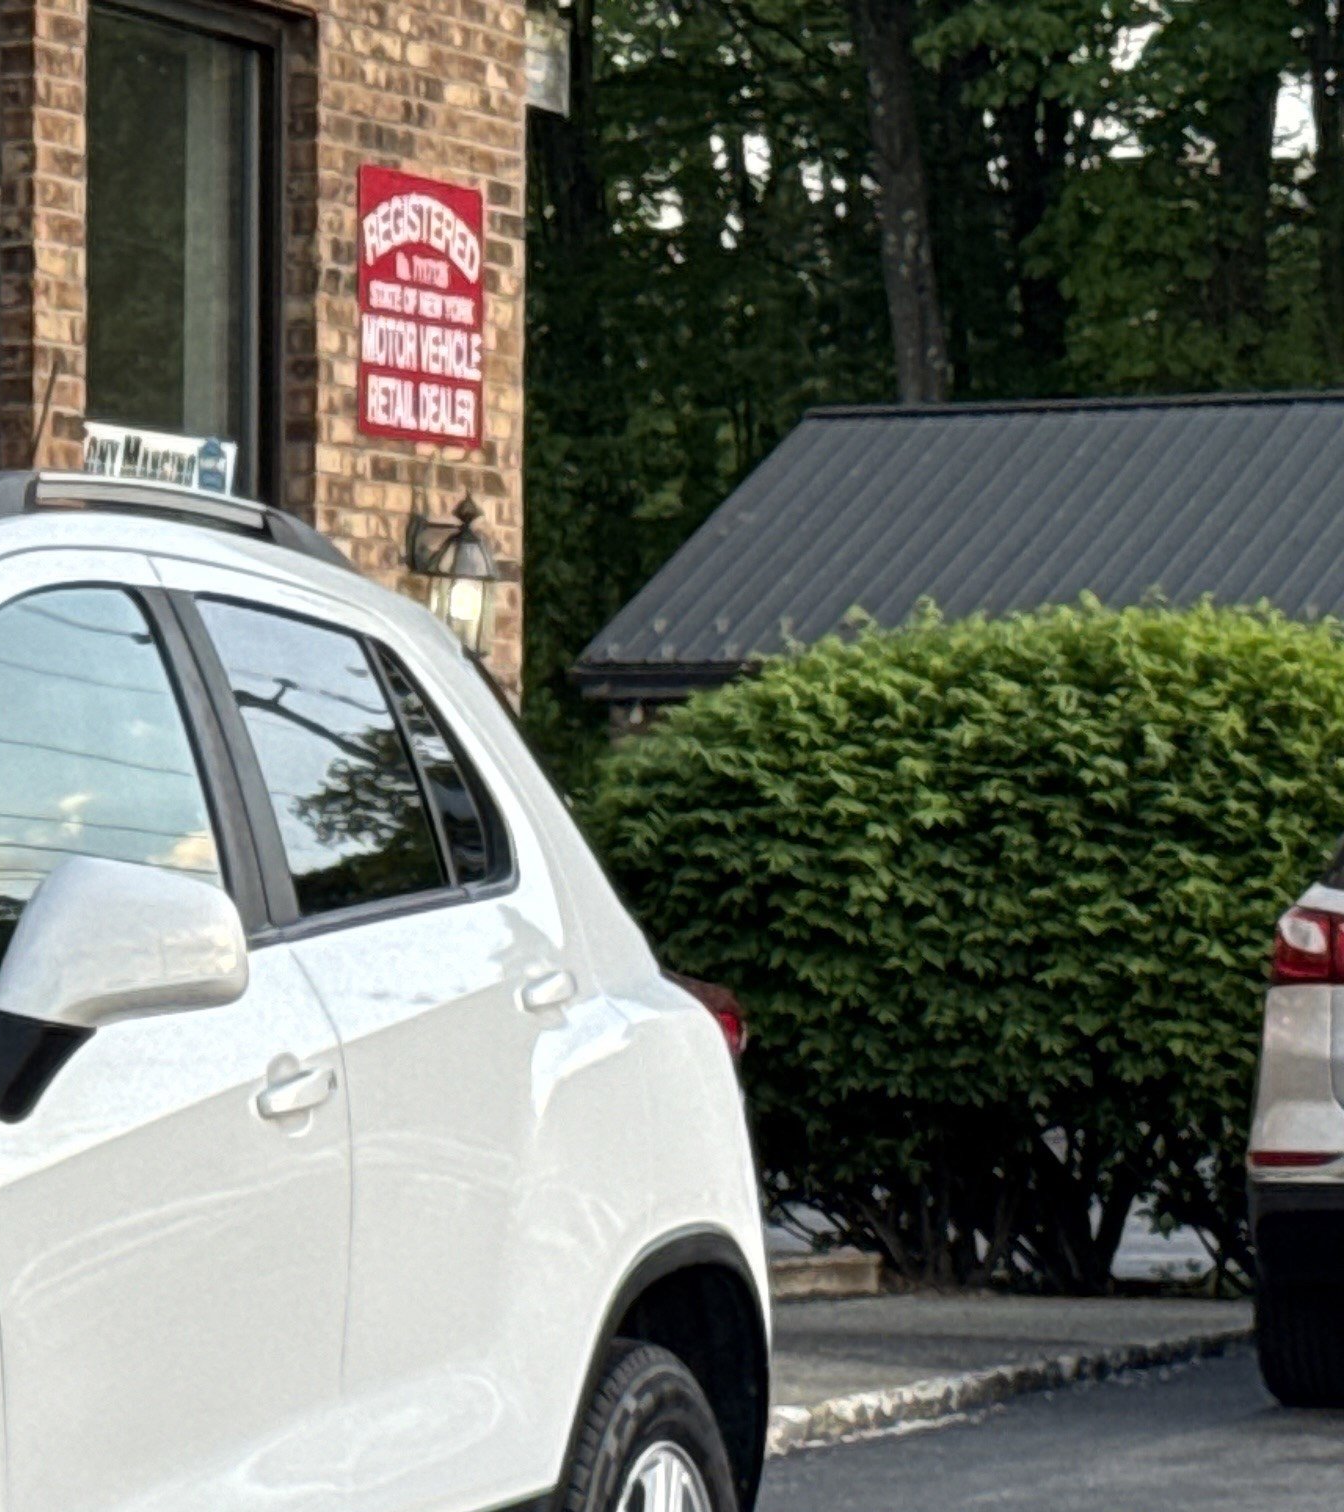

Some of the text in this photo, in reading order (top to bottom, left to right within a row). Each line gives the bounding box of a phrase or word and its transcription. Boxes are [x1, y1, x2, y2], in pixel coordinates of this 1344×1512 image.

[363, 192, 481, 284] REGISTERED
[362, 313, 482, 381] MOTOR VEHICLE
[366, 374, 476, 438] RETAIL DEALER
